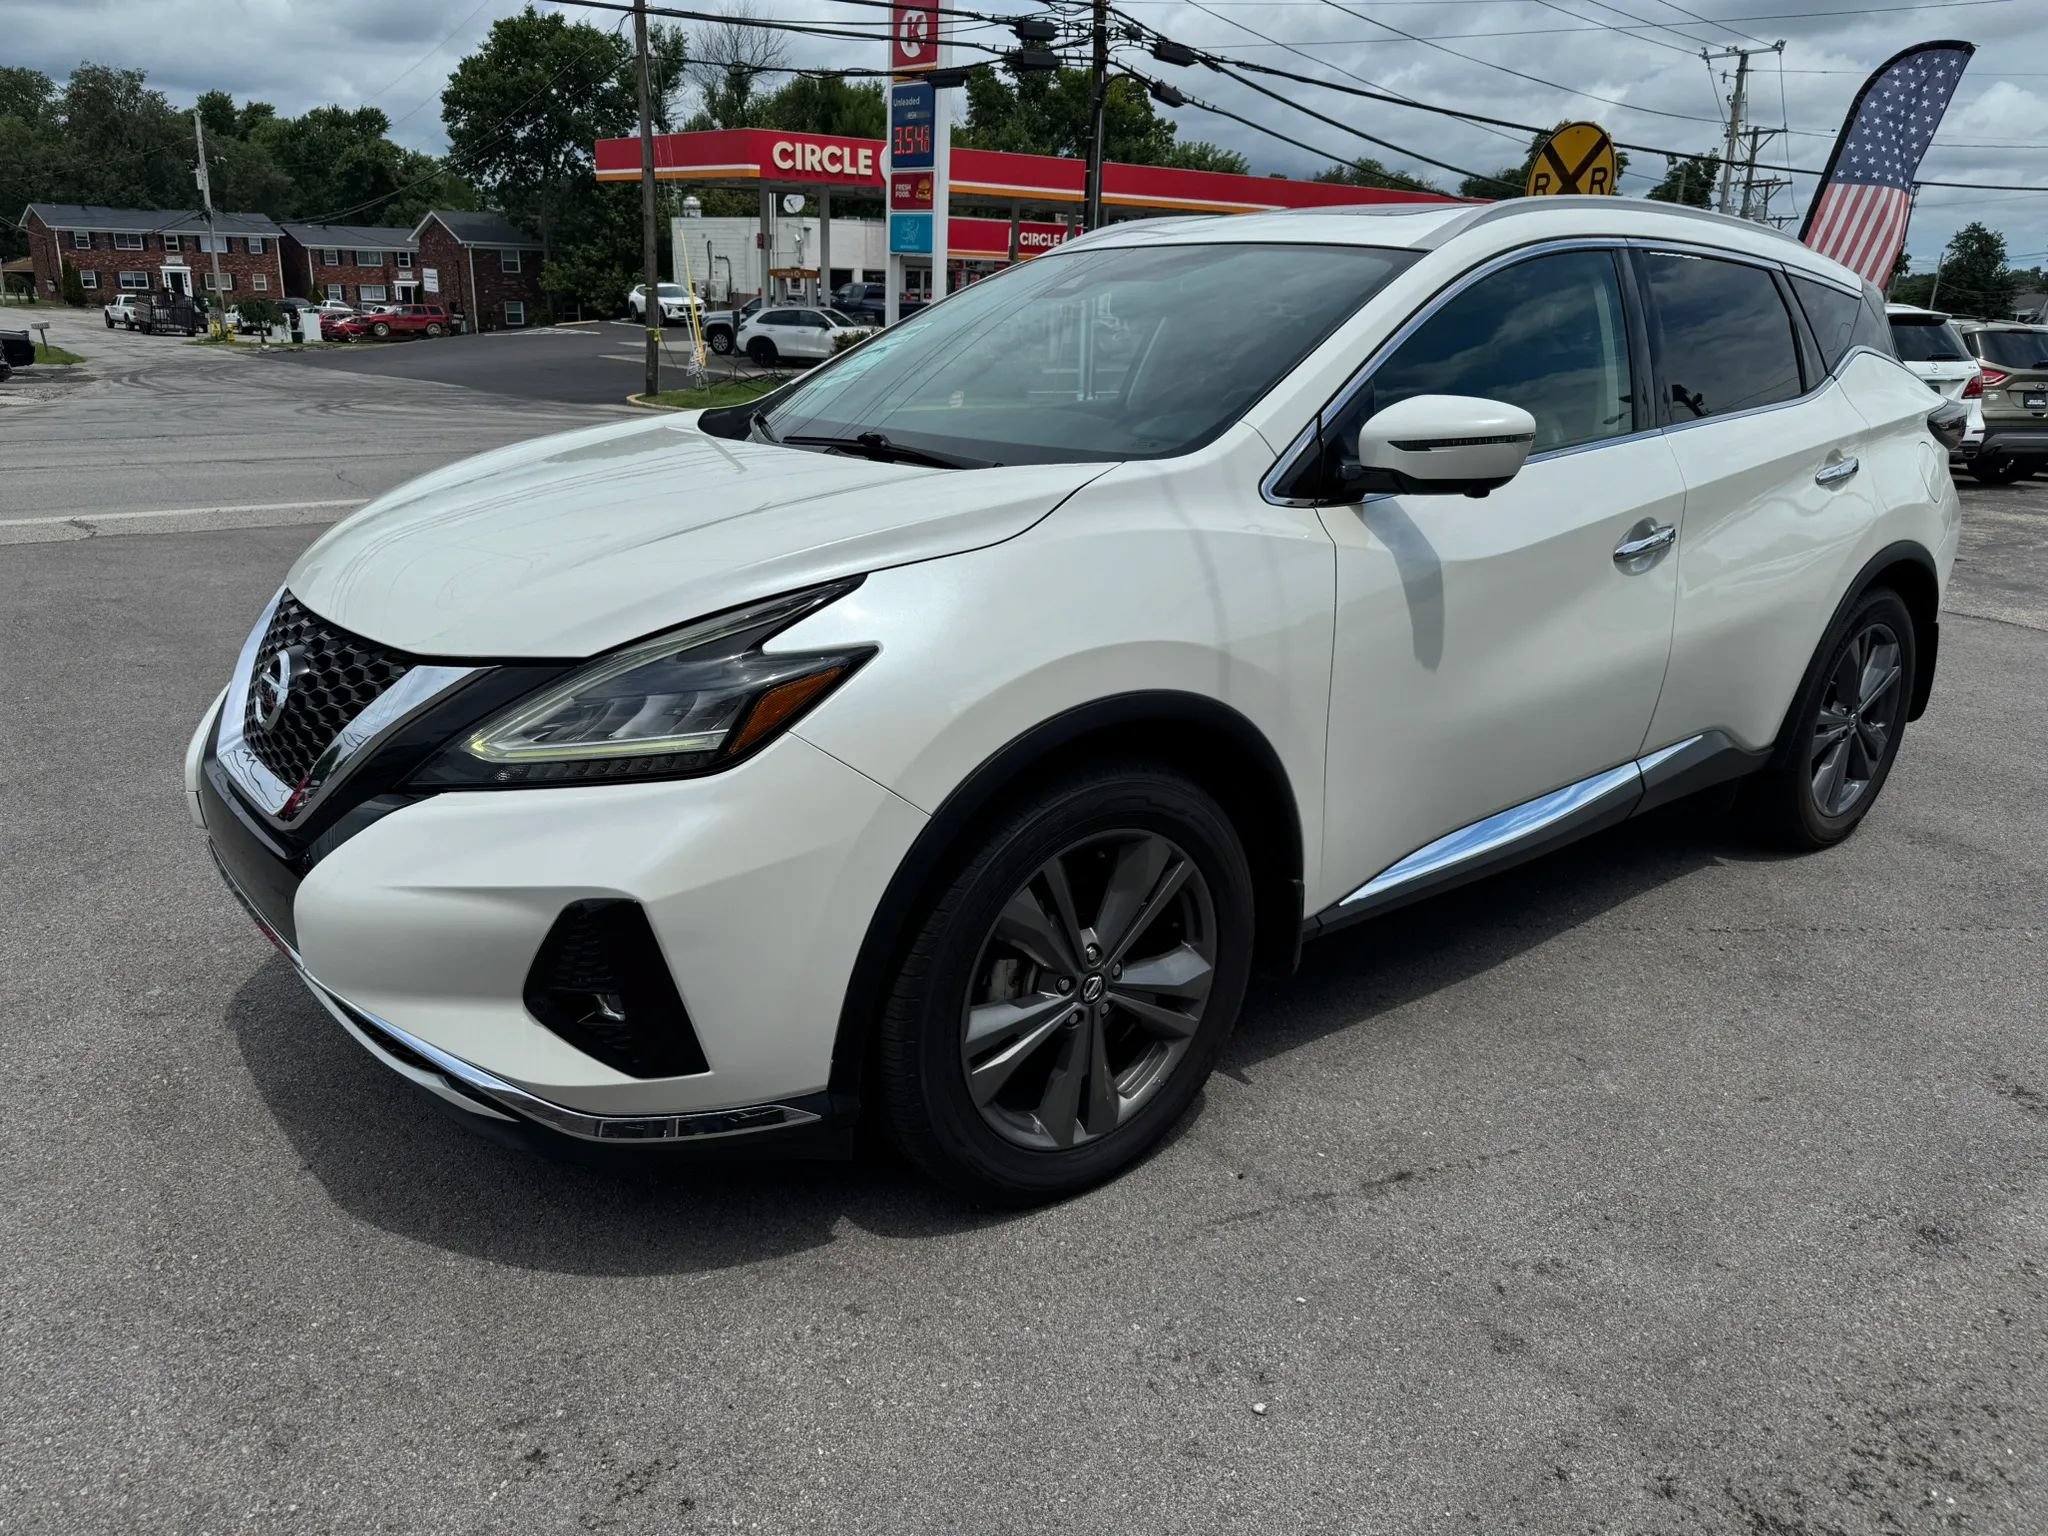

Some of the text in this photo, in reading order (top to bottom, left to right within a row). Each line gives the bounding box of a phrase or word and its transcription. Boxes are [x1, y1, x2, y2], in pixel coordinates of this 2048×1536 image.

[893, 96, 920, 107] Unleaded
[772, 141, 873, 176] CIRCLE
[1019, 231, 1061, 247] CIRCLE
